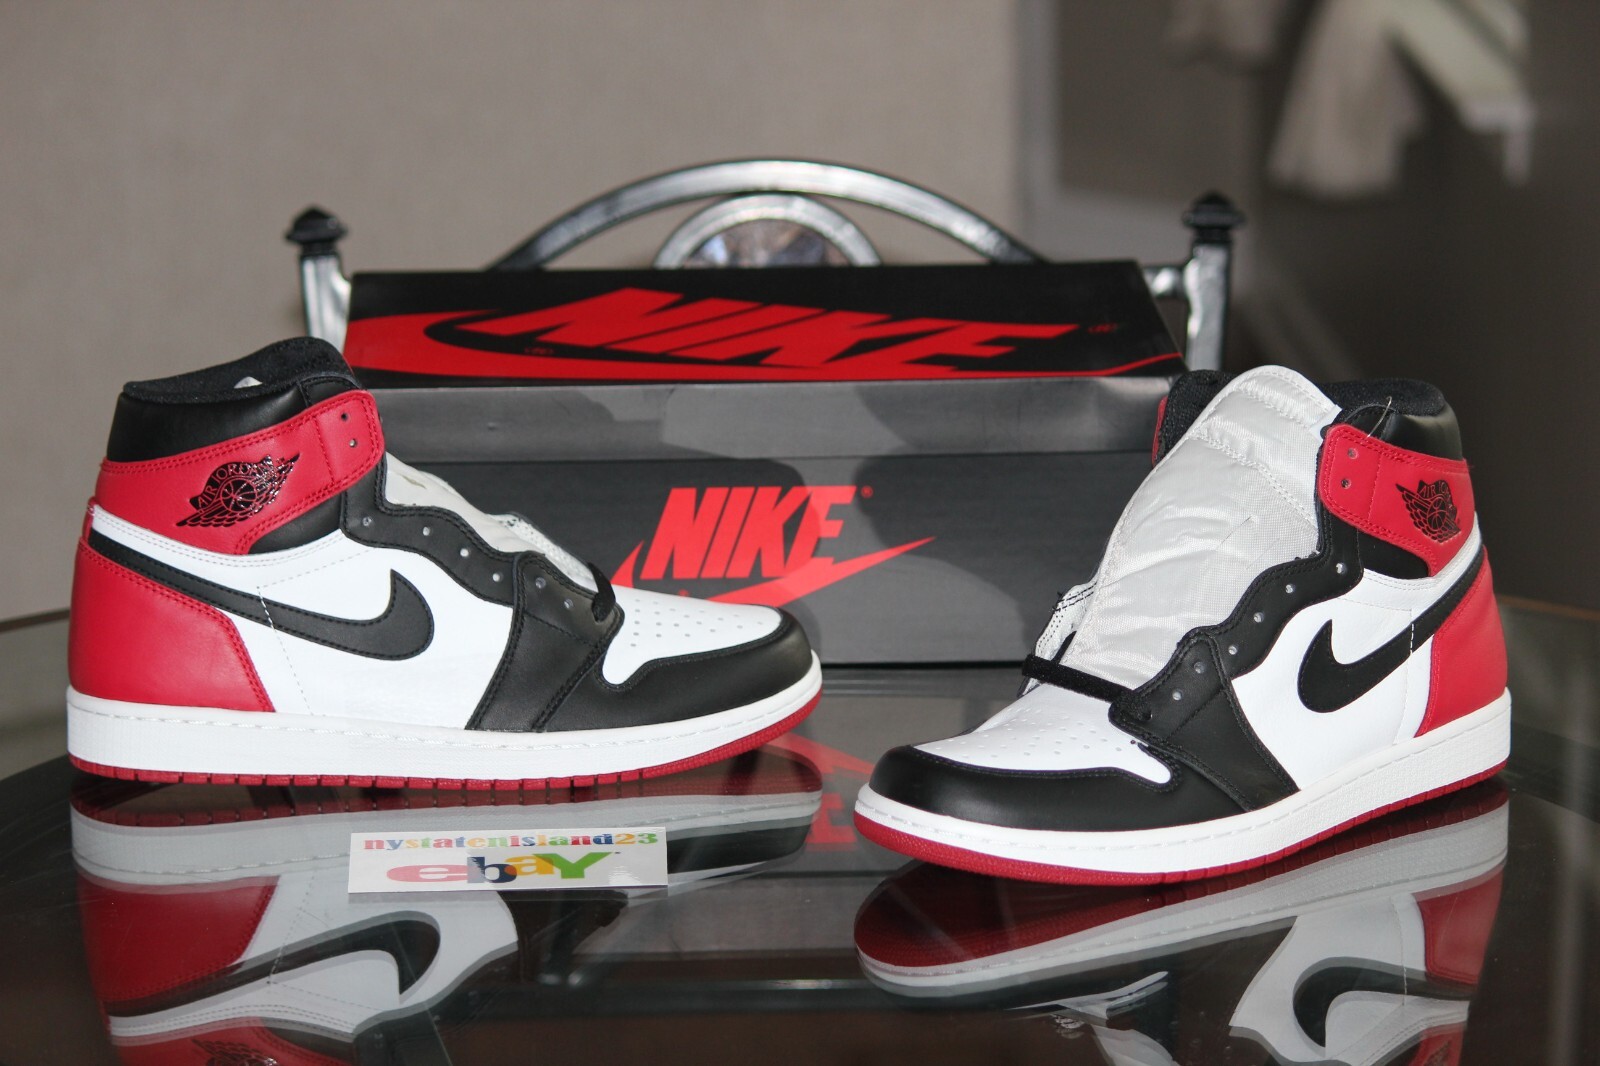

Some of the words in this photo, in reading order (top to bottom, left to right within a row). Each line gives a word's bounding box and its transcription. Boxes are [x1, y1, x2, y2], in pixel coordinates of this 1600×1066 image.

[455, 287, 1078, 371] NIKE
[197, 484, 218, 511] AIR
[639, 485, 857, 580] NIKE
[363, 832, 659, 851] nystatenisland23
